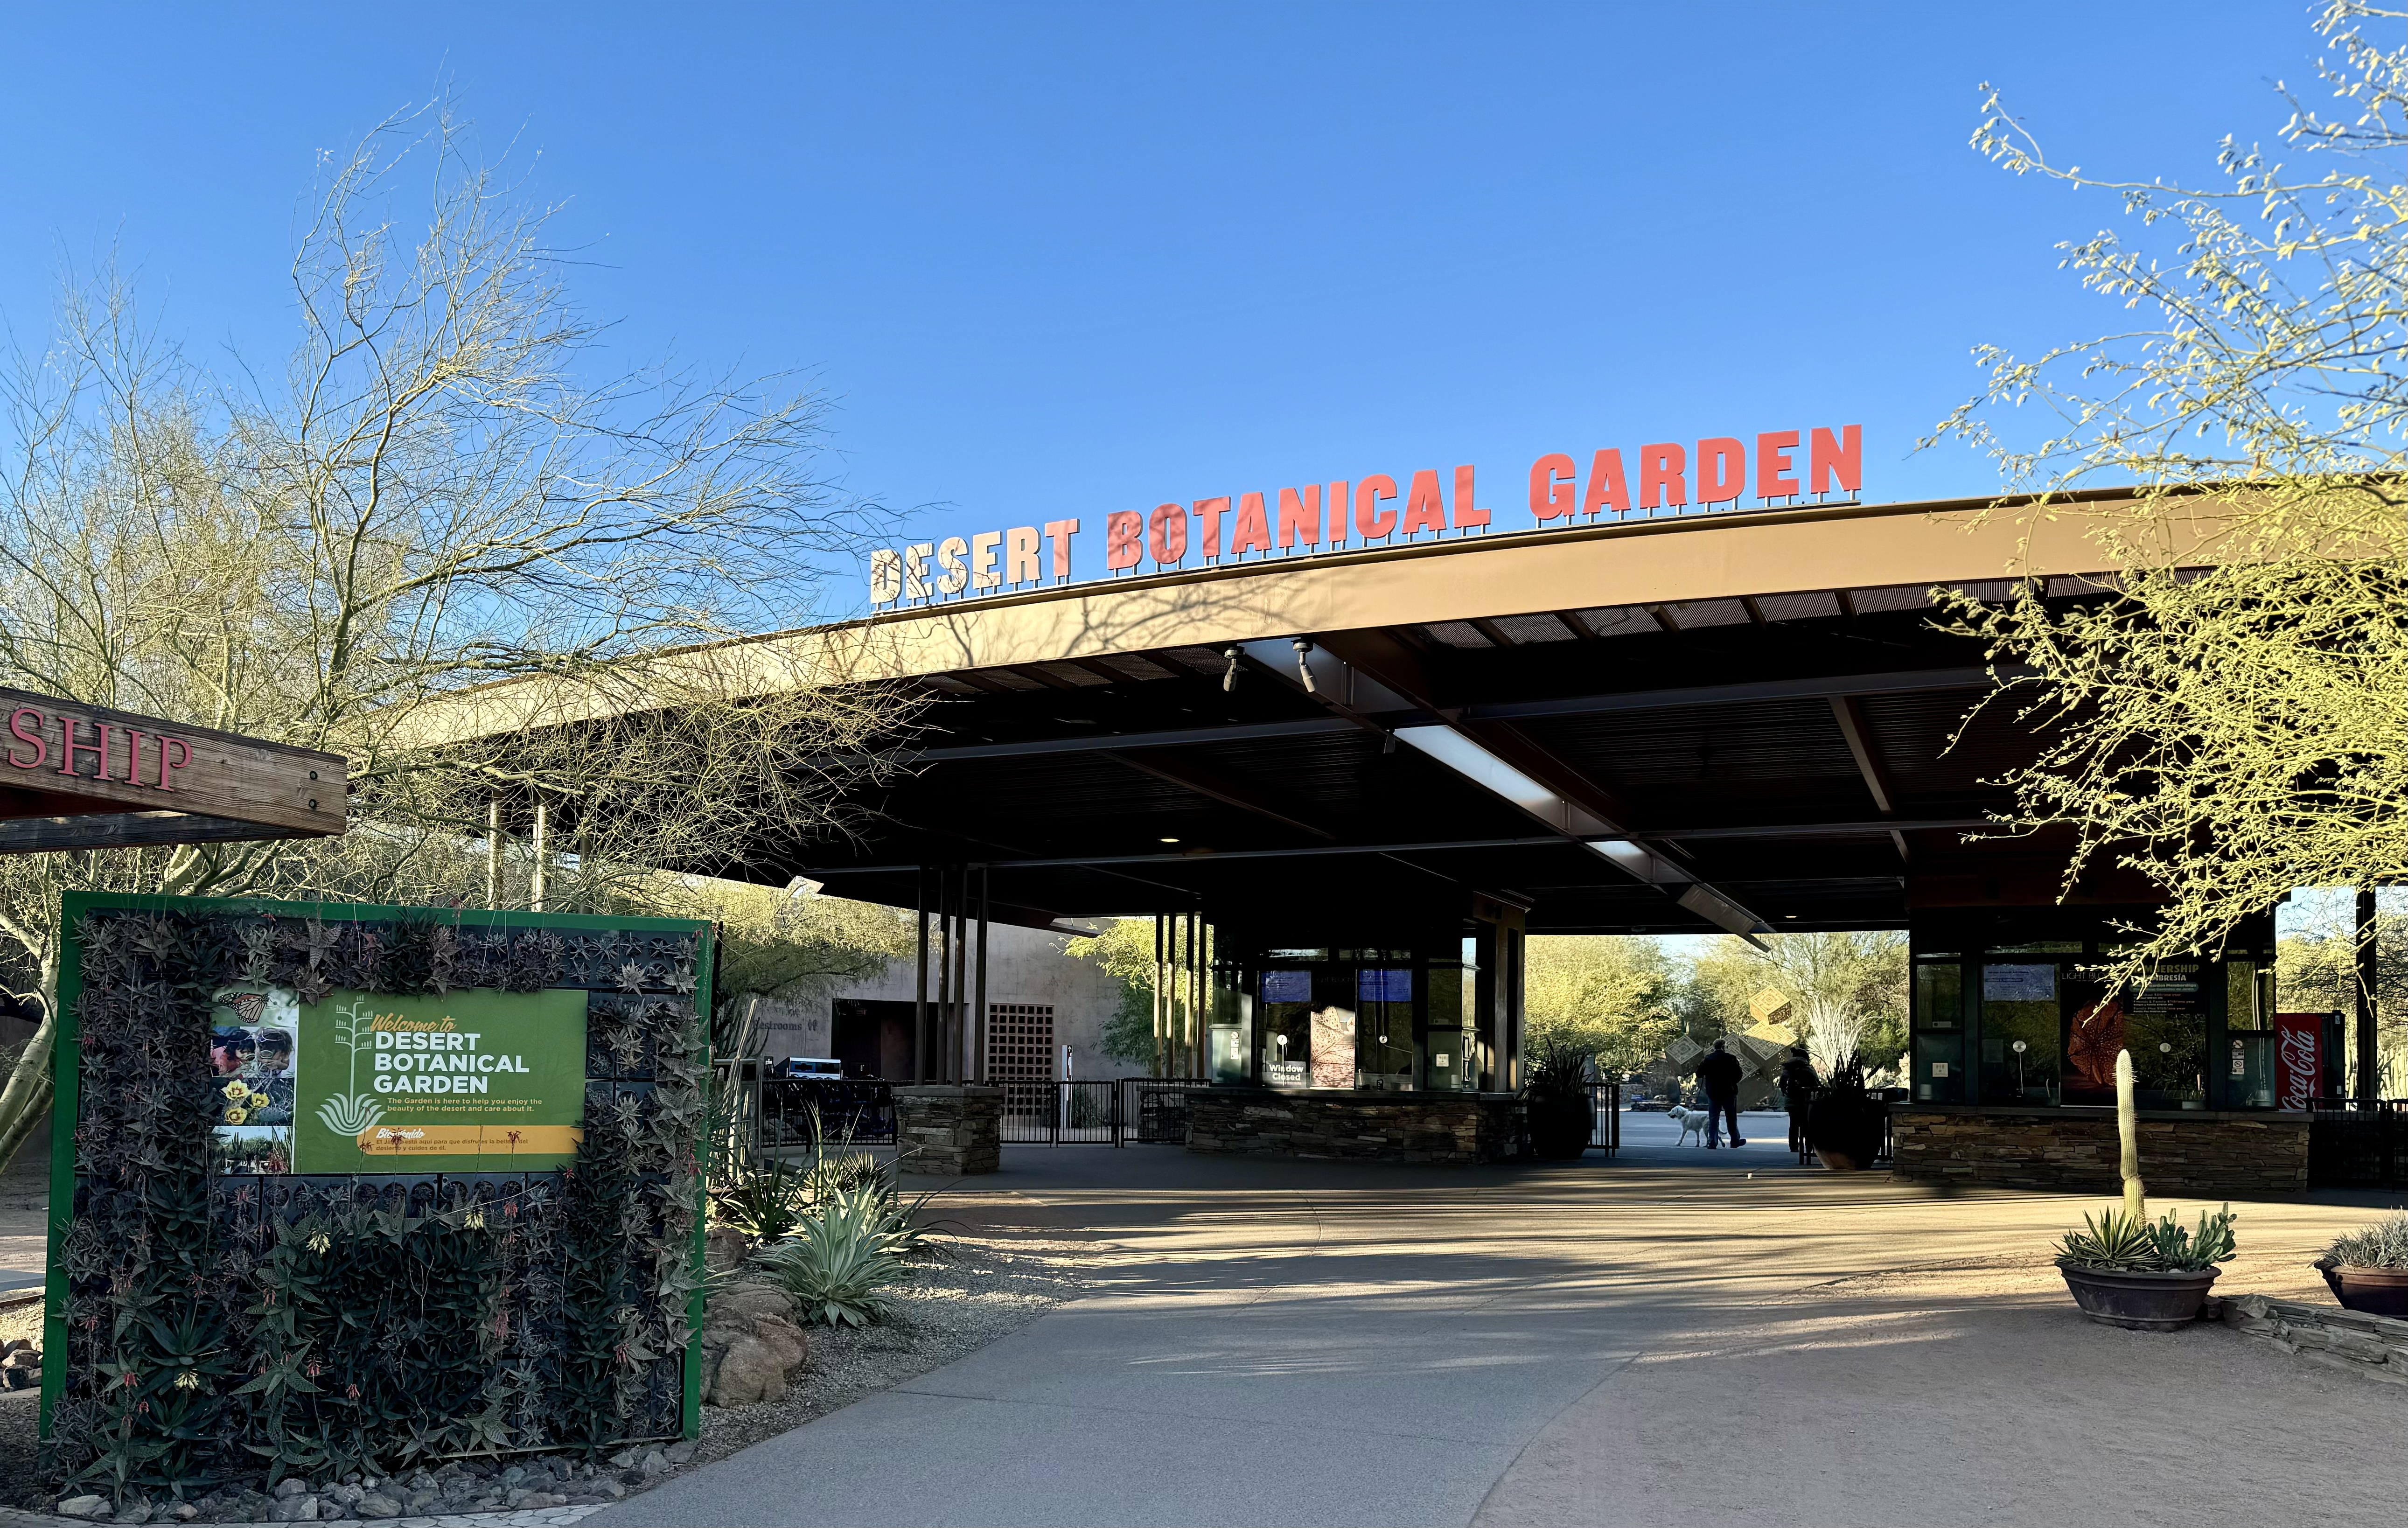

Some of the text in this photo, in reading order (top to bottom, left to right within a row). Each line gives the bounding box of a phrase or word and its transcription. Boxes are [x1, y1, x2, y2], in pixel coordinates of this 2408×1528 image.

[871, 424, 1862, 604] DESERT BOTANICAL GARDEN
[8, 708, 193, 792] SHIP
[2133, 964, 2199, 973] MBERSHIP
[370, 1012, 457, 1033] Welcome to
[753, 1020, 802, 1031] Restrooms
[375, 1031, 481, 1051] DESERT
[375, 1053, 530, 1073] BOTANICAL
[1269, 1064, 1304, 1073] Window
[374, 1074, 488, 1093] GARDEN
[1272, 1072, 1301, 1081] Closed
